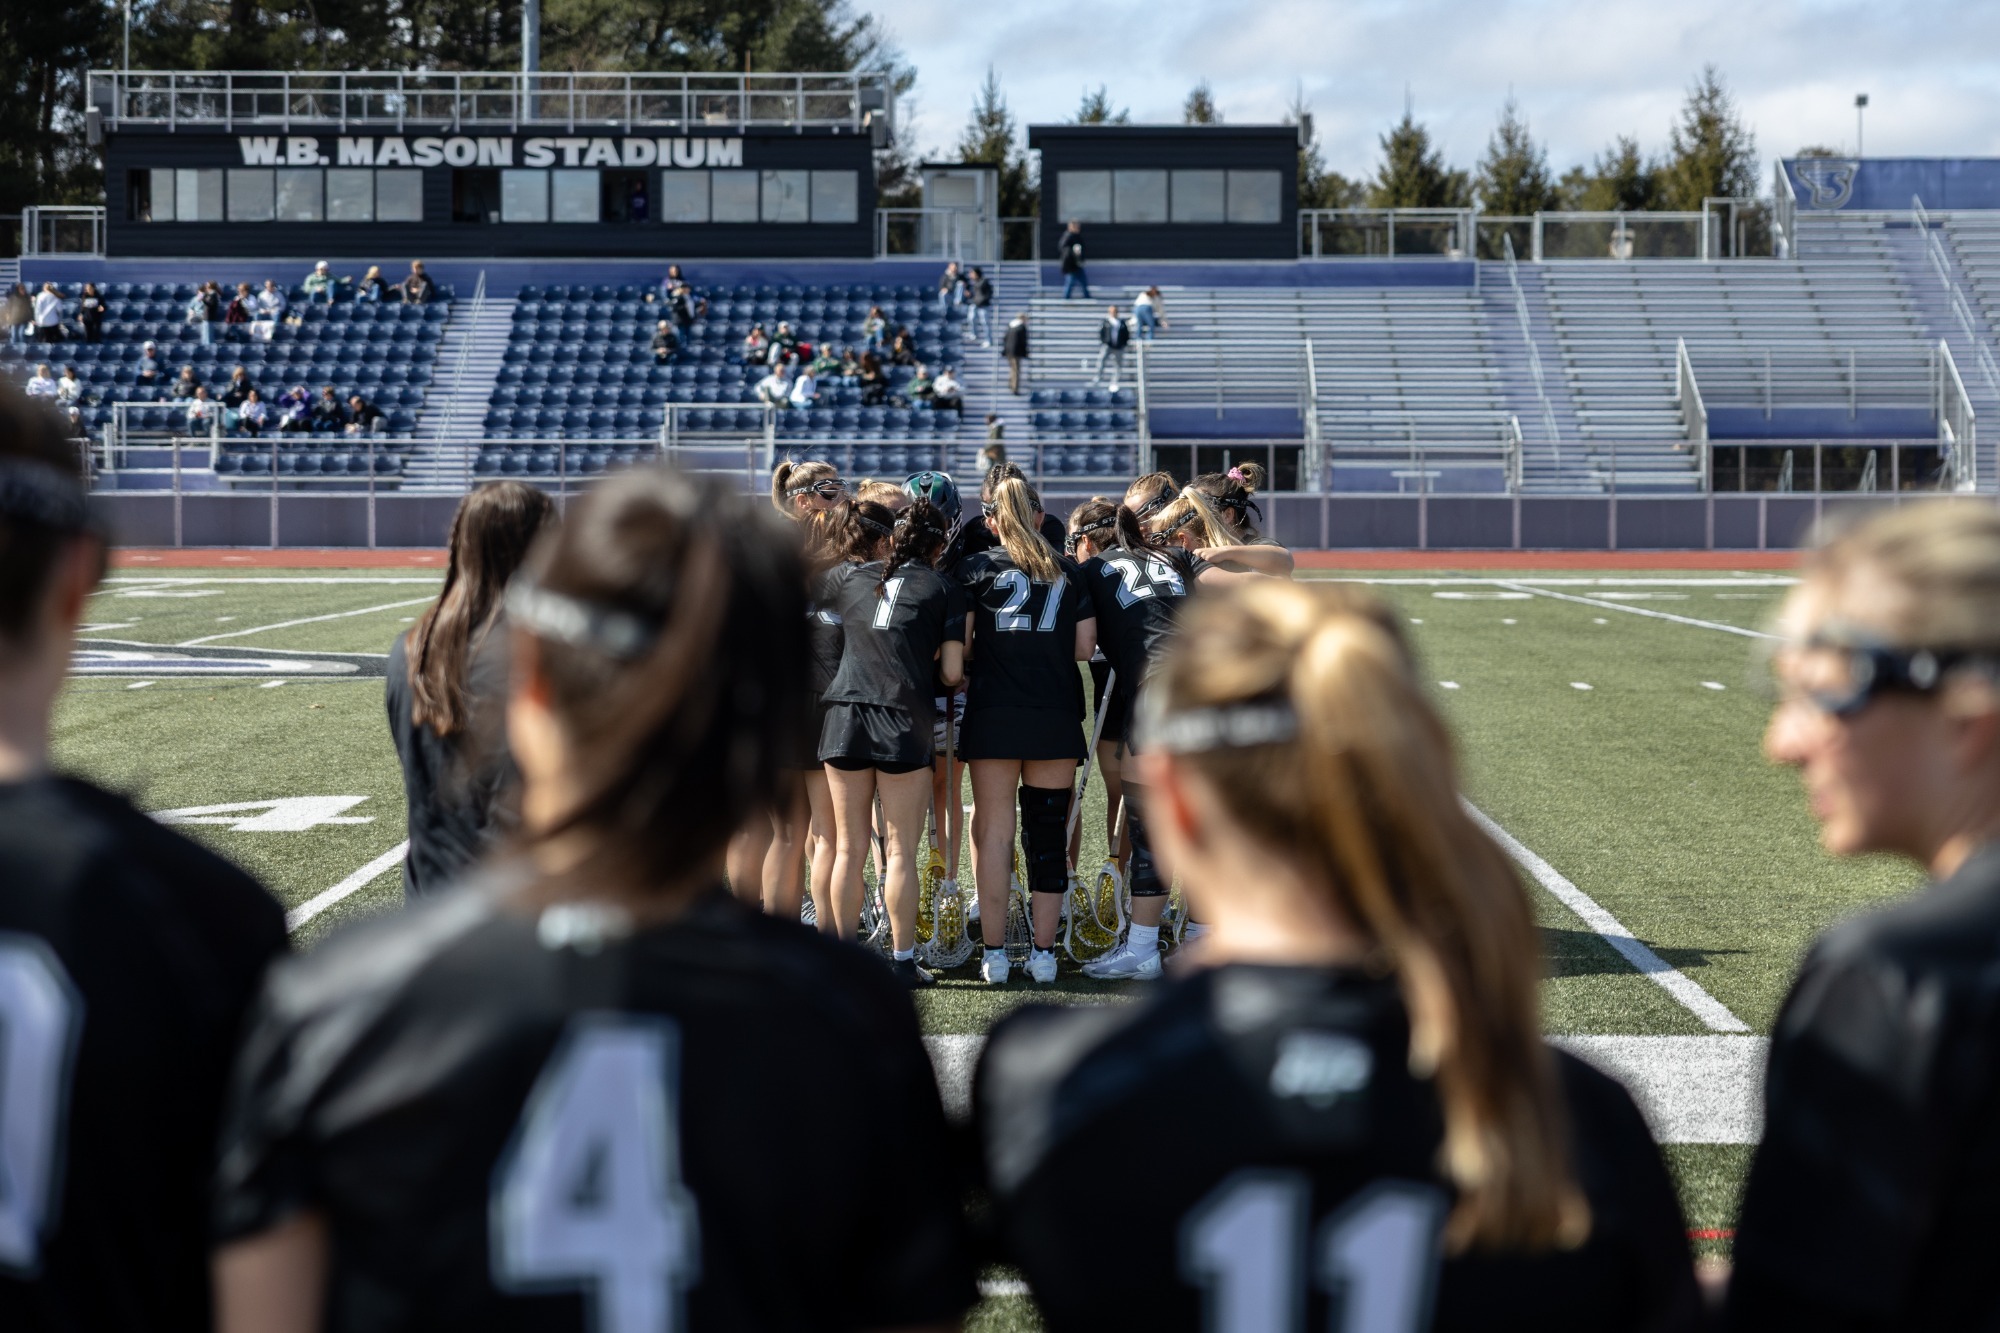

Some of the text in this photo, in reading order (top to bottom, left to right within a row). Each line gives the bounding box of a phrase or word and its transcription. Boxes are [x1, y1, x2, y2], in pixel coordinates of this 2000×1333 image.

[239, 136, 743, 167] W.B. MASON STADIUM
[1083, 522, 1099, 532] STX
[872, 576, 905, 630] 1
[993, 568, 1068, 632] 27
[1100, 551, 1187, 610] 24
[487, 1010, 700, 1333] 4
[1176, 1168, 1447, 1333] 11
